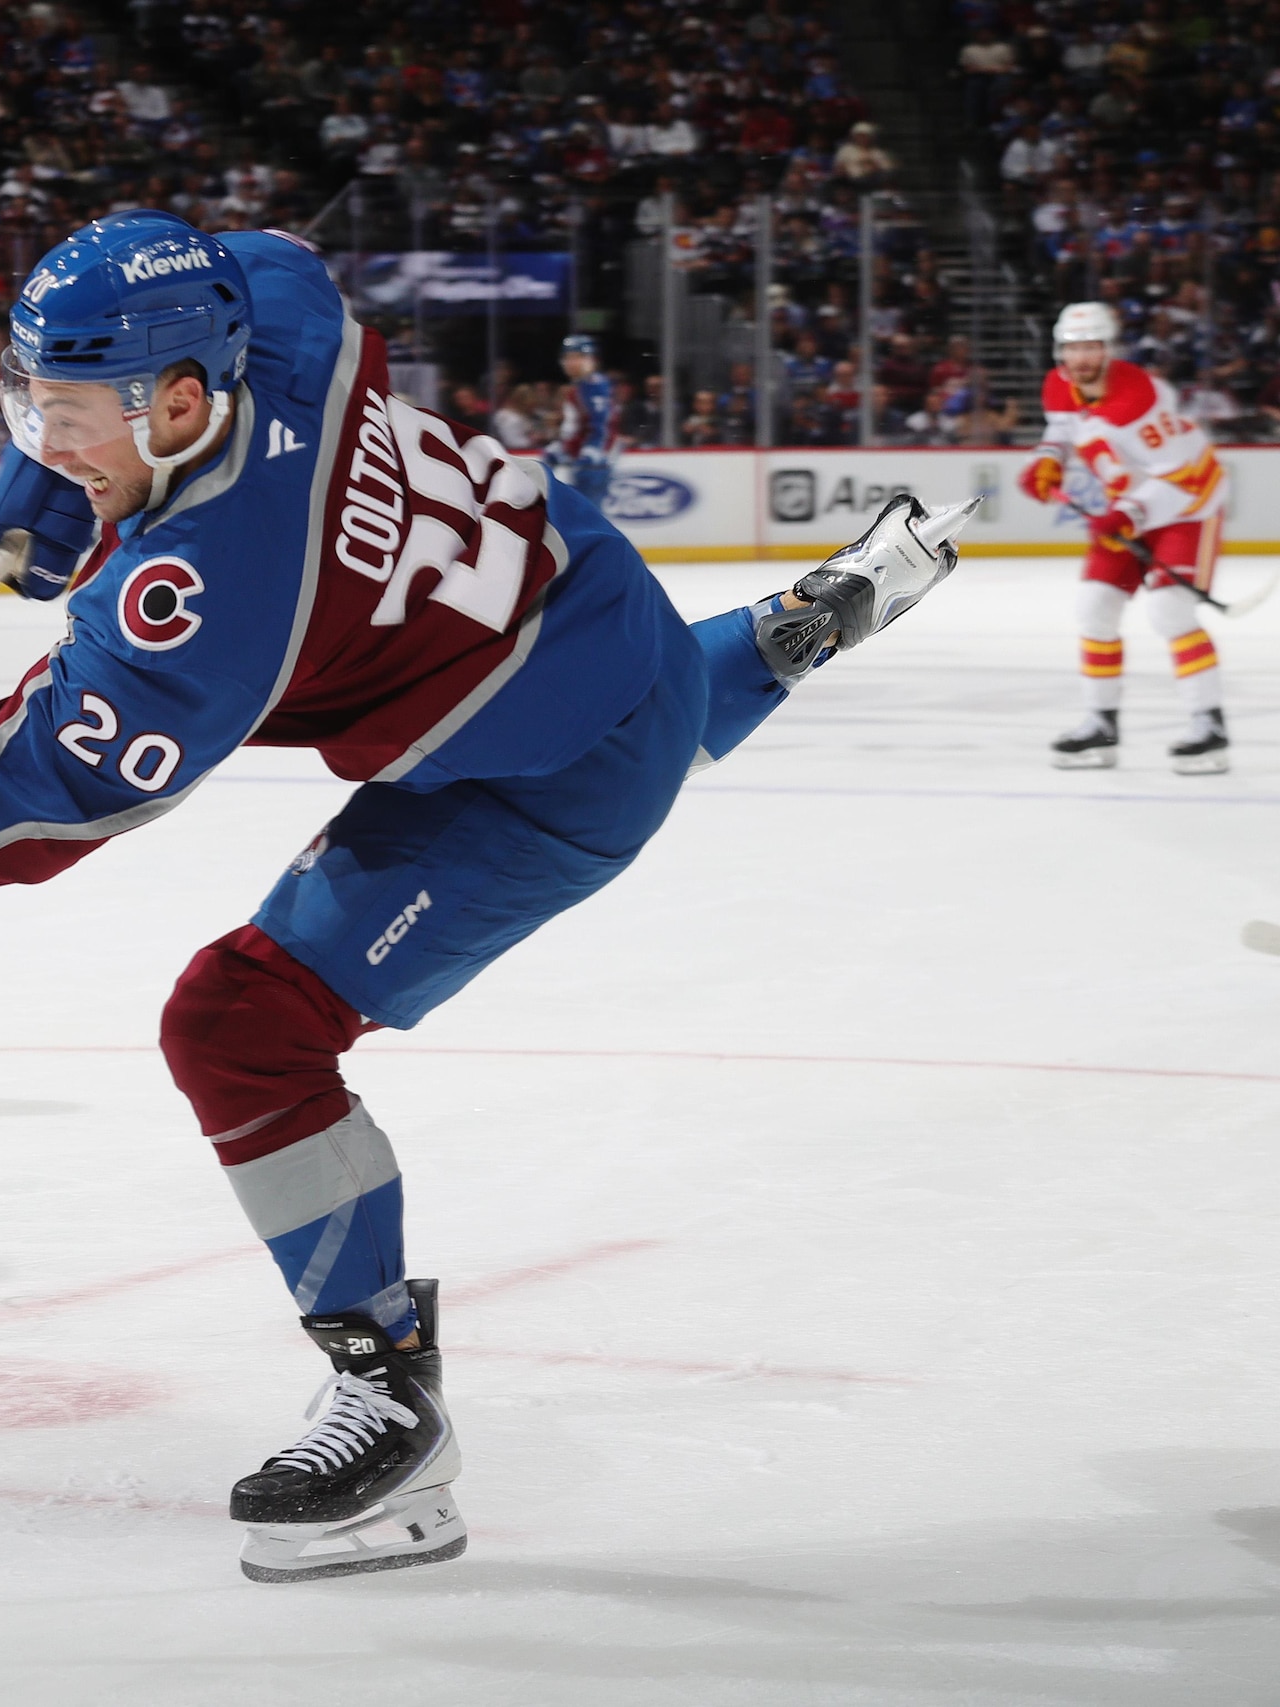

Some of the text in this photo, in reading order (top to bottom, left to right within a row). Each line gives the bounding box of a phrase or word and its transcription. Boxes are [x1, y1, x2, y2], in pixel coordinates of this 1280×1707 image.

[23, 267, 58, 303] 20
[120, 246, 213, 285] Kiewit
[12, 319, 40, 346] CCM
[335, 387, 405, 583] COLTON
[55, 690, 184, 793] 20
[366, 889, 433, 966] CCM
[347, 1337, 377, 1355] 20
